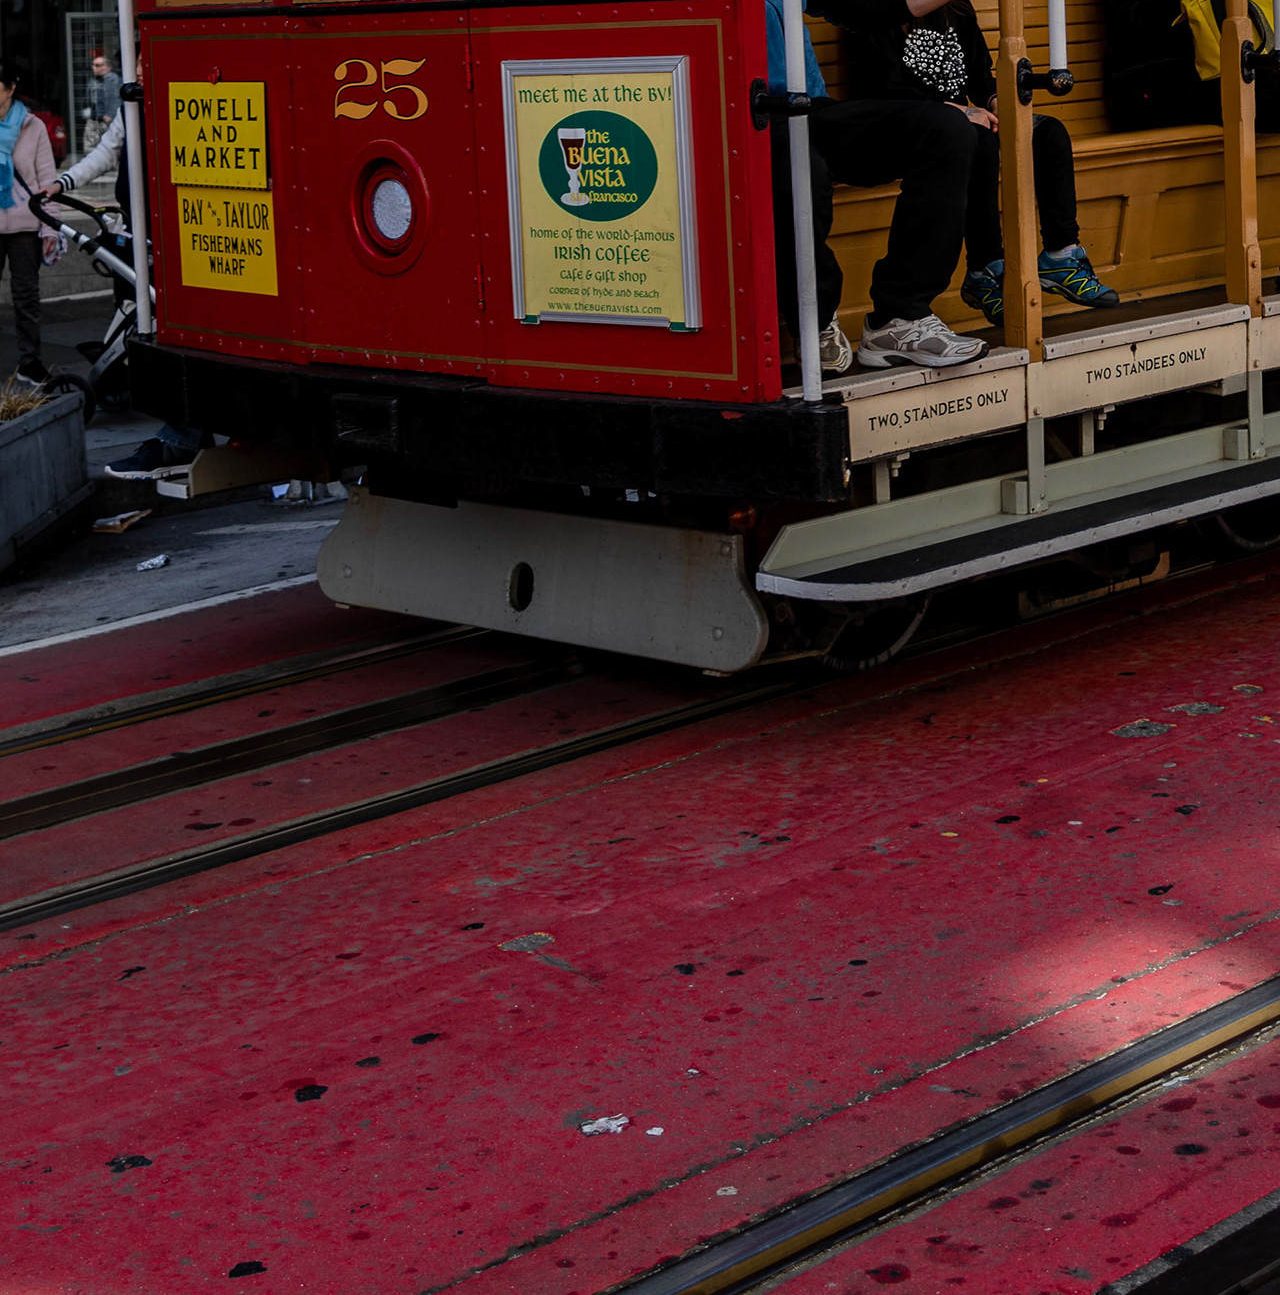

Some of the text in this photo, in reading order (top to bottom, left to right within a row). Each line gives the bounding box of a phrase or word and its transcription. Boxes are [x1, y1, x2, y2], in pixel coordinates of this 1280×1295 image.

[334, 58, 428, 120] 25
[518, 87, 558, 104] meet
[563, 88, 587, 103] me
[593, 87, 609, 103] at
[614, 85, 643, 102] the
[175, 98, 258, 121] POWELL
[196, 125, 237, 142] AND
[586, 129, 610, 144] the
[175, 146, 260, 170] MARKET
[182, 198, 269, 230] BAY AND TAYLOR
[530, 227, 559, 239] home
[561, 228, 574, 240] of
[576, 228, 593, 240] the
[192, 234, 263, 256] FISHERMANS
[209, 256, 245, 276] WHARF
[585, 270, 592, 280] &
[582, 286, 590, 297] of
[615, 288, 631, 298] and
[1086, 347, 1207, 384] TWO STANDEES ONLY
[868, 388, 1009, 431] TWO STANDEES ONLY
